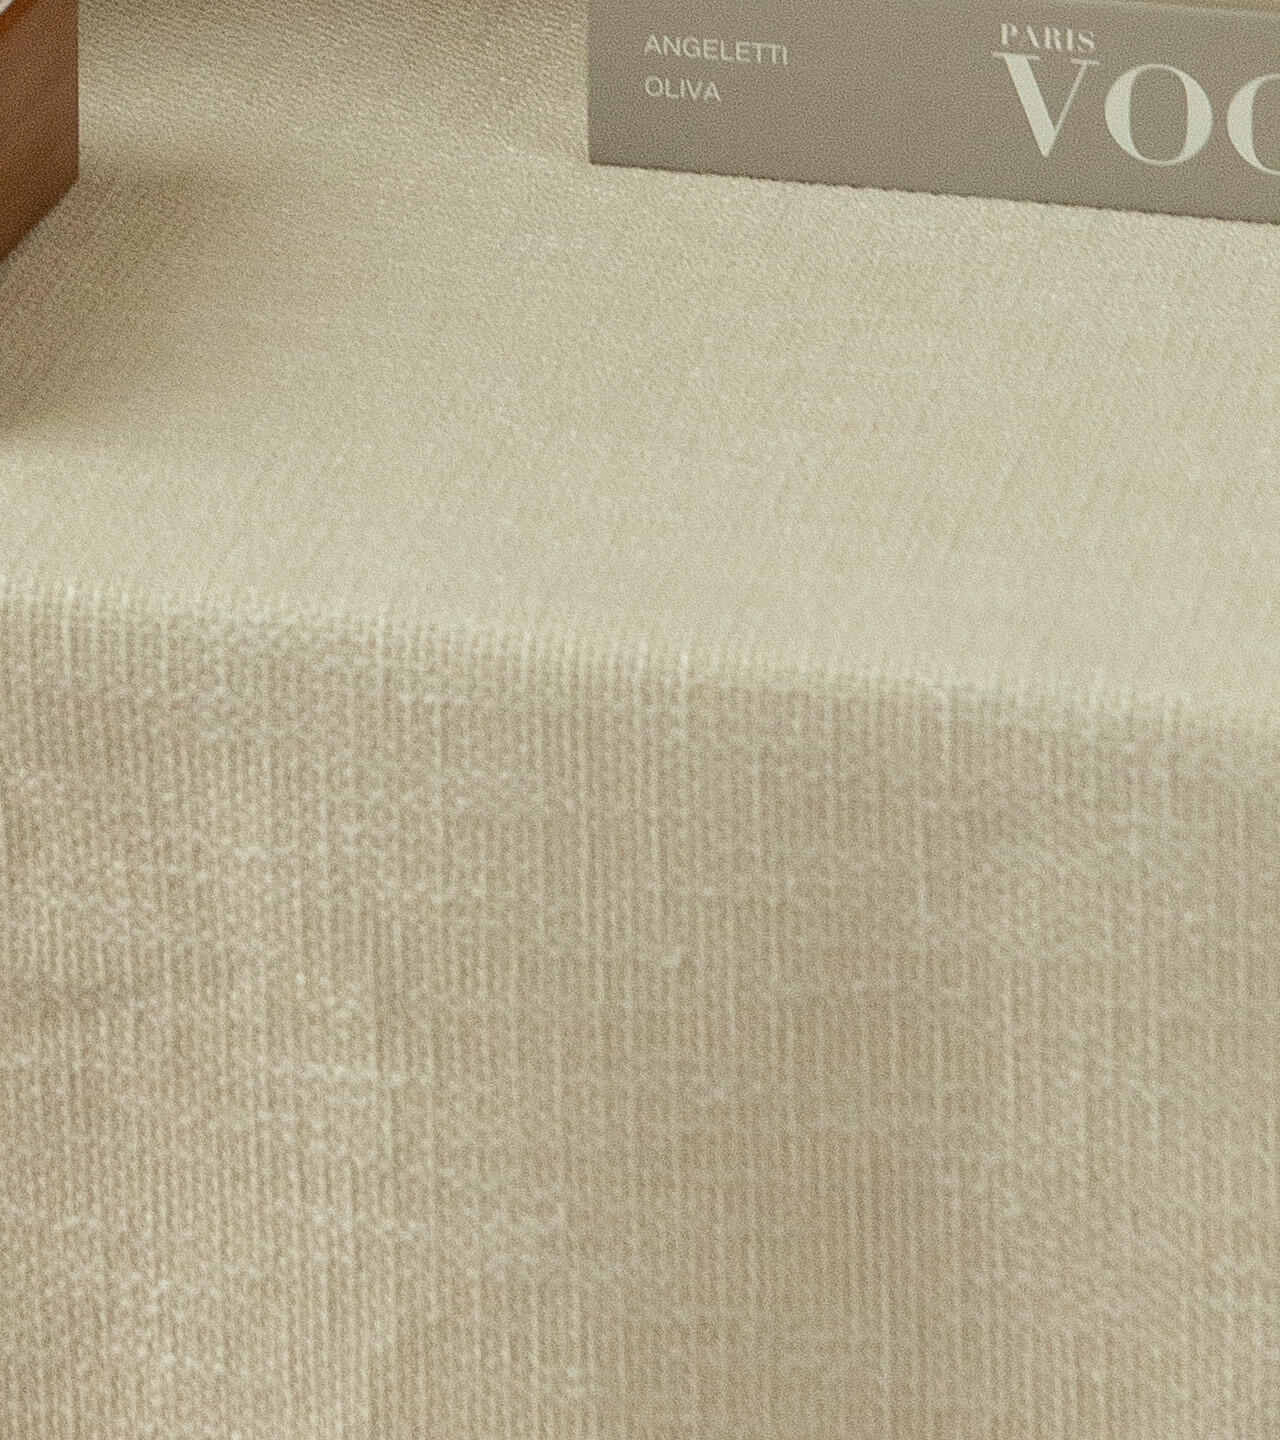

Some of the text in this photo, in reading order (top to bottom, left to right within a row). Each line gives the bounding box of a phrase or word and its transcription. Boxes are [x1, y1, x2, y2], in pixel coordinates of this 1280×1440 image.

[643, 34, 790, 66] ANGELETTI
[1000, 22, 1096, 53] PARIS
[644, 74, 722, 103] OLIVA
